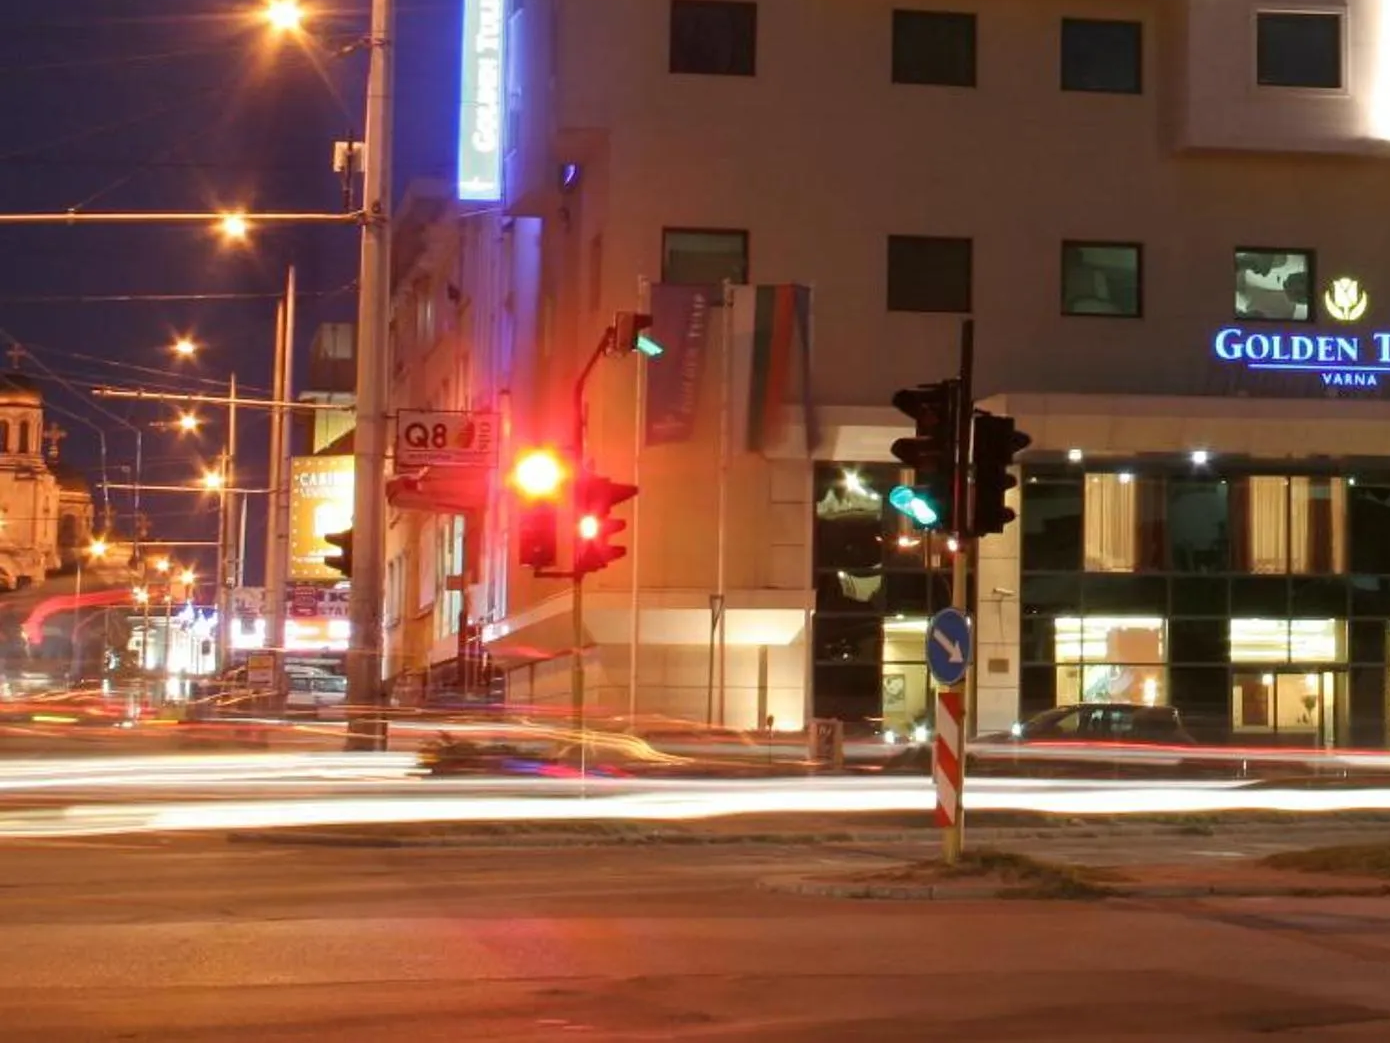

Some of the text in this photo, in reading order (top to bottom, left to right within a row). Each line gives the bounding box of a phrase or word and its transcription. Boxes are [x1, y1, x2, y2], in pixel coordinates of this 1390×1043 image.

[1215, 328, 1358, 361] GOLDEN
[1322, 373, 1377, 386] VARNA
[405, 422, 447, 449] Q8
